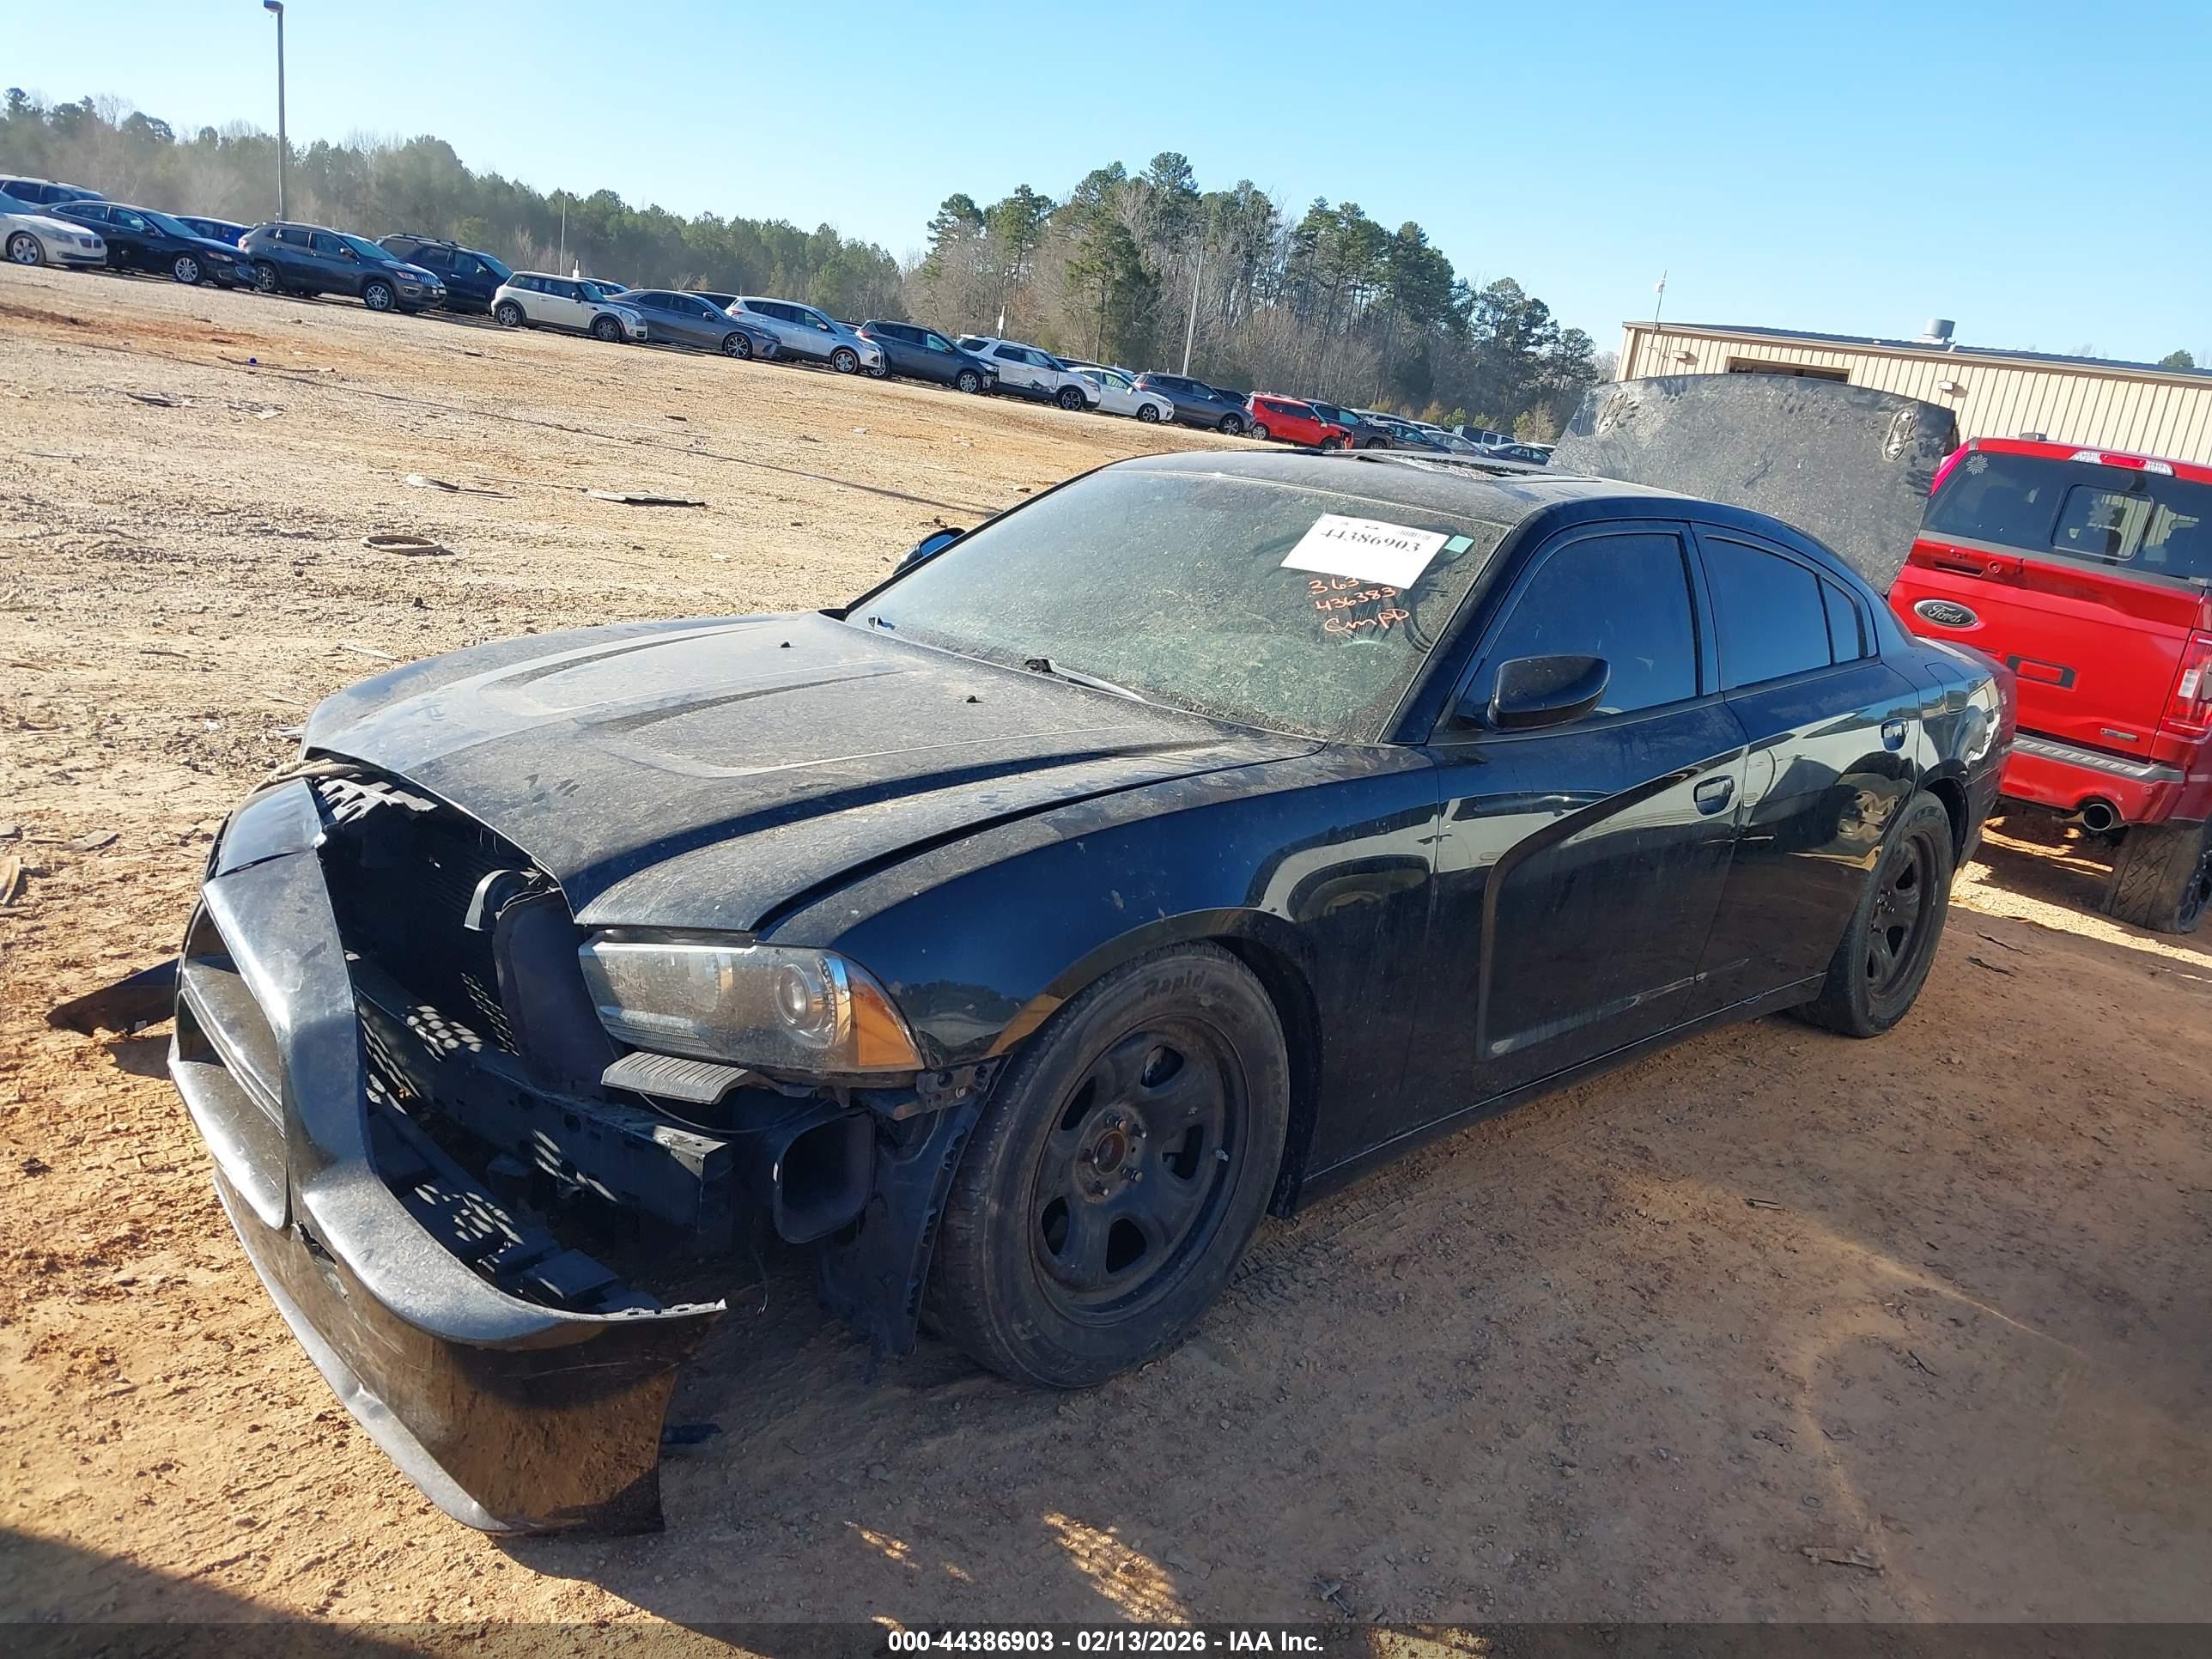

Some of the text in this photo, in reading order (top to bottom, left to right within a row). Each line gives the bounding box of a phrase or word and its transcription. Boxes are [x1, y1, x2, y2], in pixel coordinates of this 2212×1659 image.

[1320, 529, 1420, 551] 44386903
[1315, 587, 1396, 611] 436383
[1928, 605, 1964, 623] Ford
